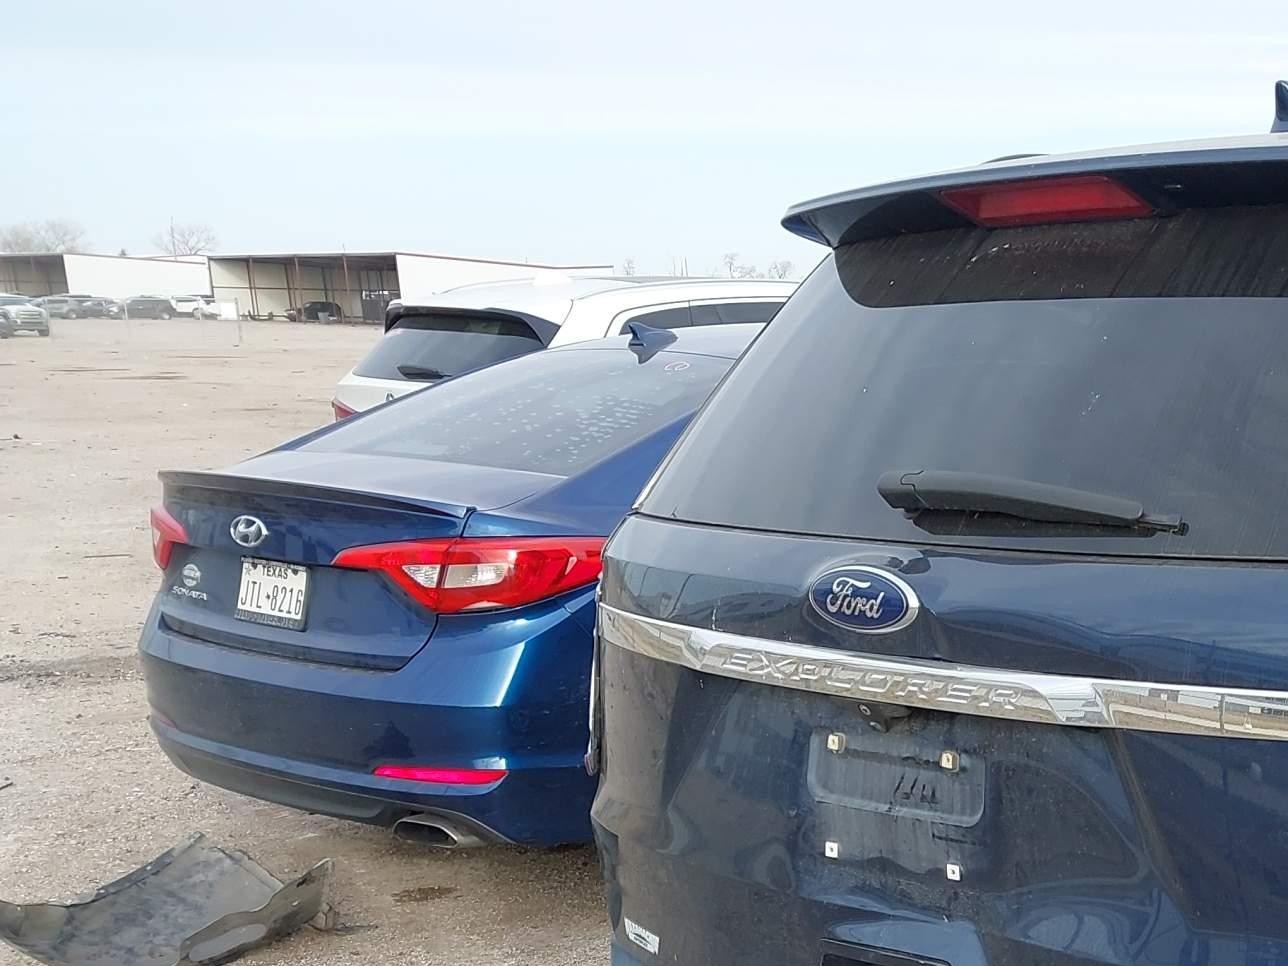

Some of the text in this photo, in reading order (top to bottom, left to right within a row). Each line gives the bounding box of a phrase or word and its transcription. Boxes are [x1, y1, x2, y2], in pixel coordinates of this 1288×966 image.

[261, 565, 289, 580] TEXAS
[171, 585, 208, 601] SONATA
[240, 580, 304, 616] JTL 8216
[826, 576, 885, 620] Ford
[722, 650, 1023, 710] EXPLORER
